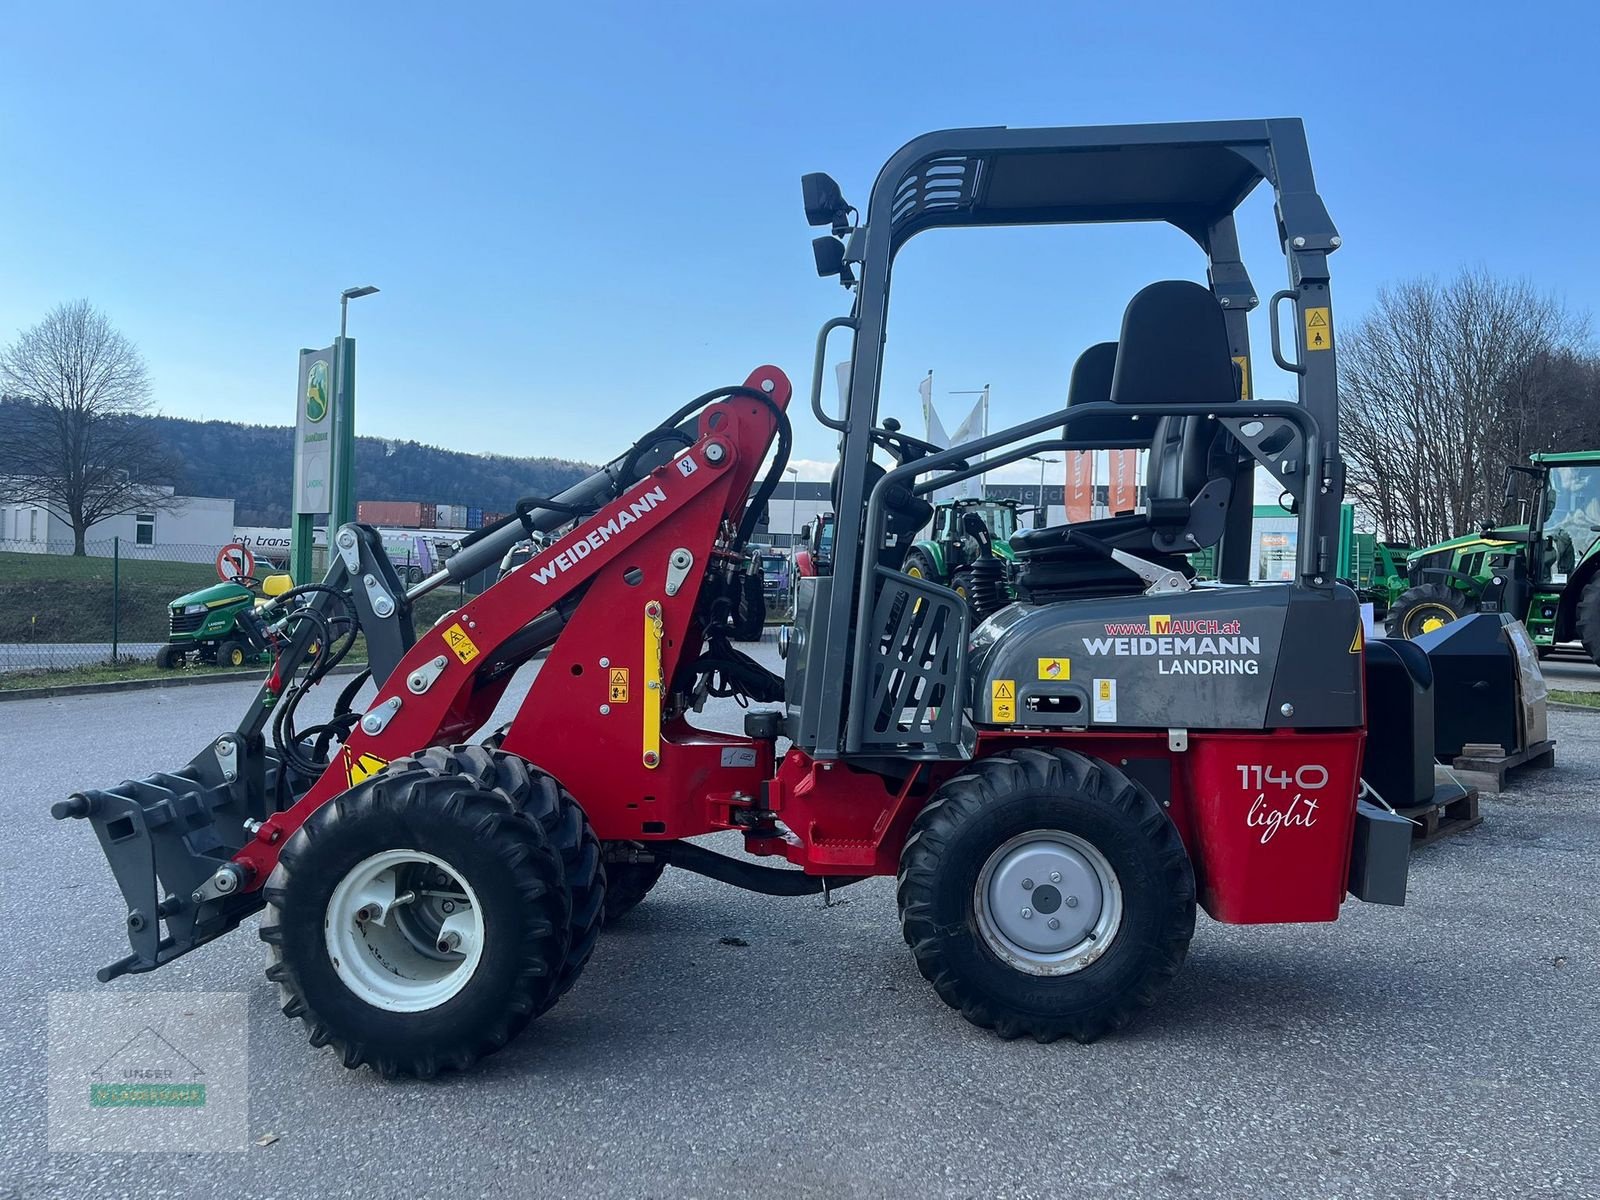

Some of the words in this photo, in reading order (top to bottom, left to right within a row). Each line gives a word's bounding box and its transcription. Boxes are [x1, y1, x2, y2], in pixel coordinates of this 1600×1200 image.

[255, 535, 292, 547] trans
[530, 485, 668, 586] WEIDEMANN
[1104, 619, 1241, 636] www.MAUCH.at
[1082, 636, 1260, 656] WEIDEMANN
[1158, 659, 1259, 675] LANDRING
[1236, 764, 1329, 790] 1140
[1247, 793, 1320, 844] light
